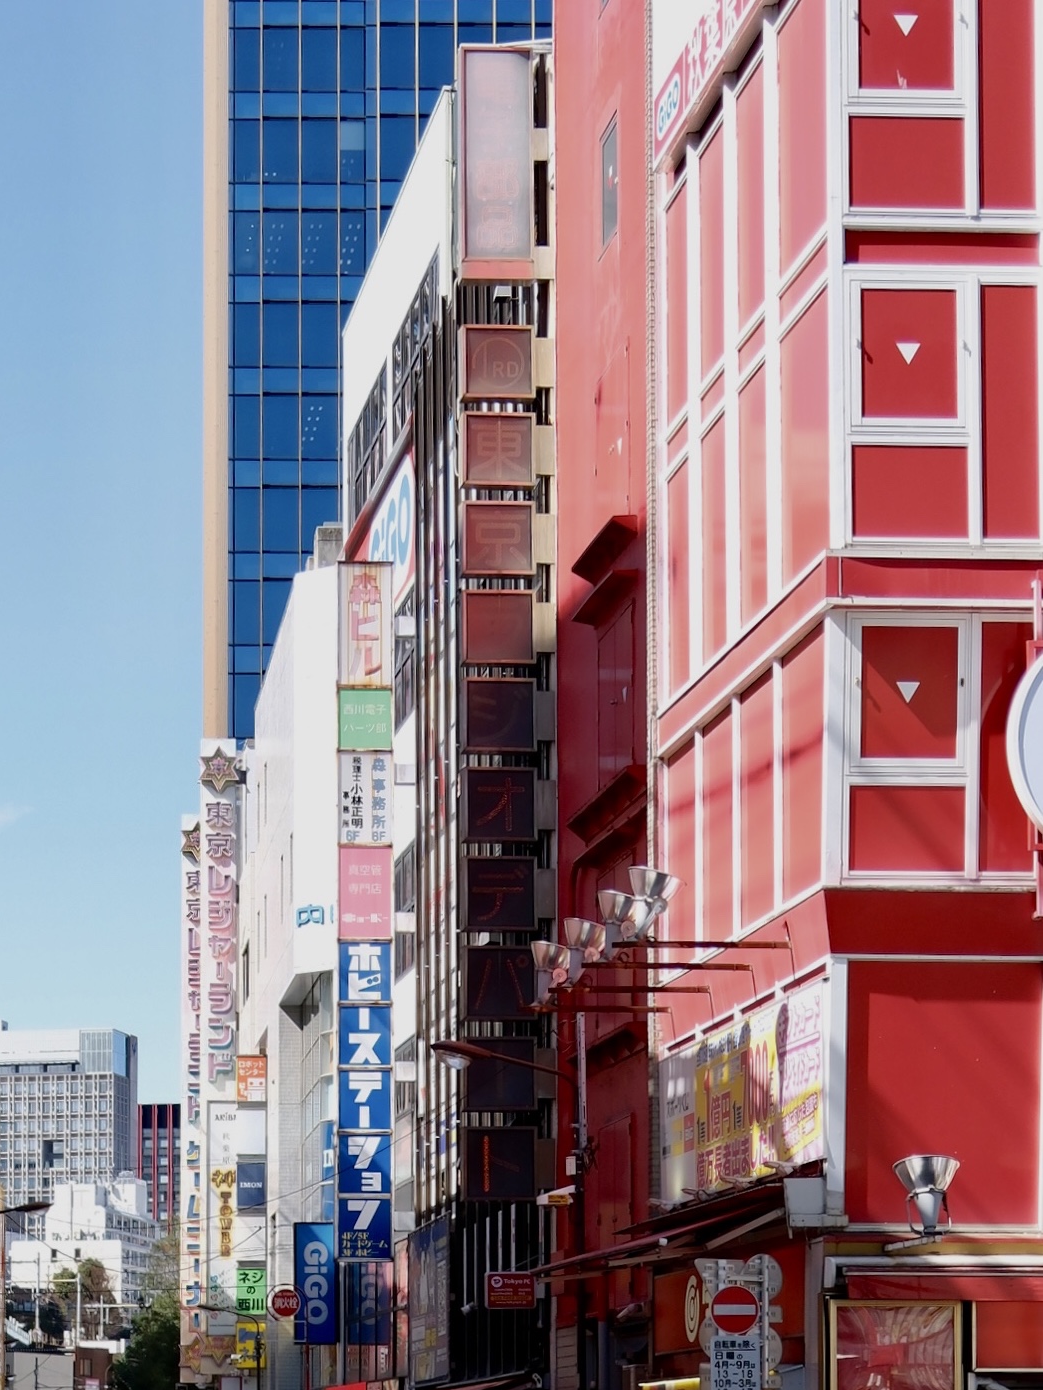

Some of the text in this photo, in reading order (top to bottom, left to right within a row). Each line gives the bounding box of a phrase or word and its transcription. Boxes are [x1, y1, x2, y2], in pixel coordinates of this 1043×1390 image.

[240, 1181, 263, 1189] IMON
[303, 1241, 329, 1325] GiGO
[238, 1298, 264, 1311] 西川
